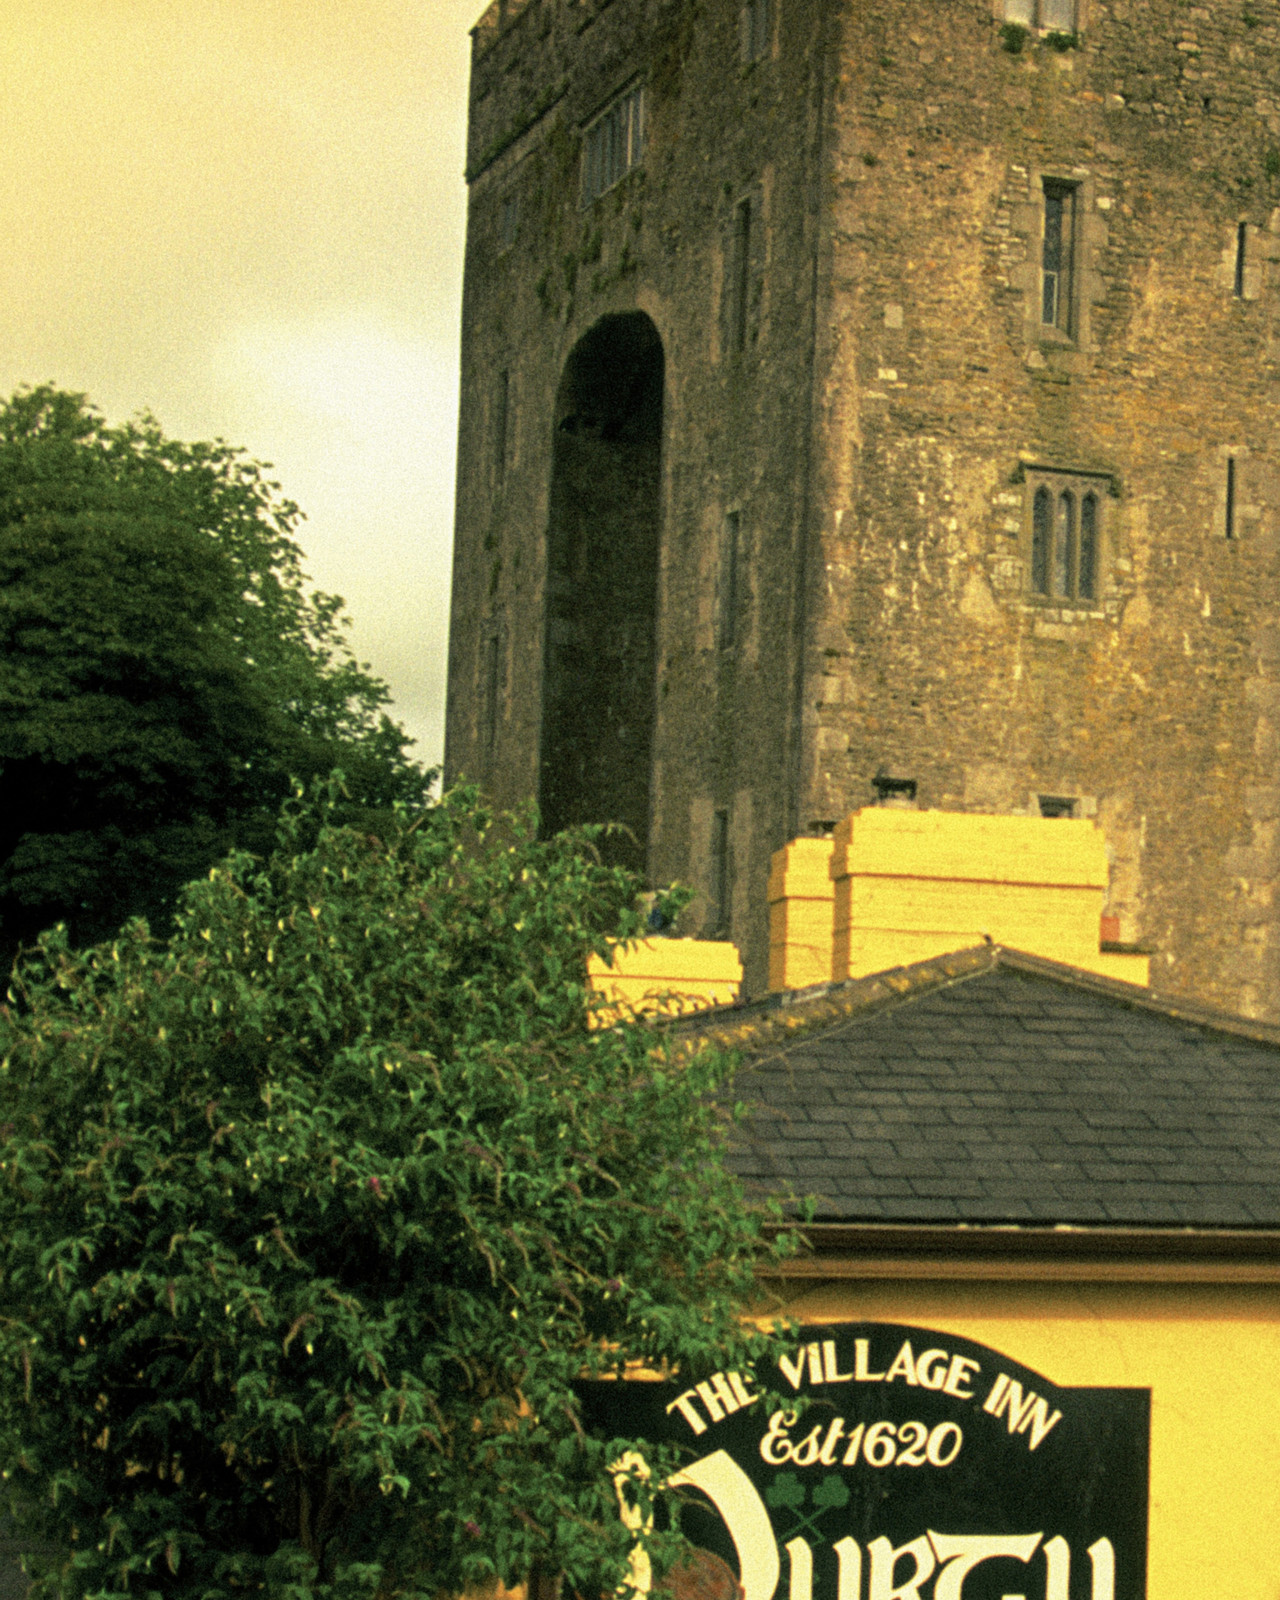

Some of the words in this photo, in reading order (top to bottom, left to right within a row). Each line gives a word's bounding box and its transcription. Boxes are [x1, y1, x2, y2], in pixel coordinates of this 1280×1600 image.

[666, 1361, 766, 1436] THE
[779, 1338, 981, 1399] VILLAGE
[983, 1372, 1063, 1451] INN
